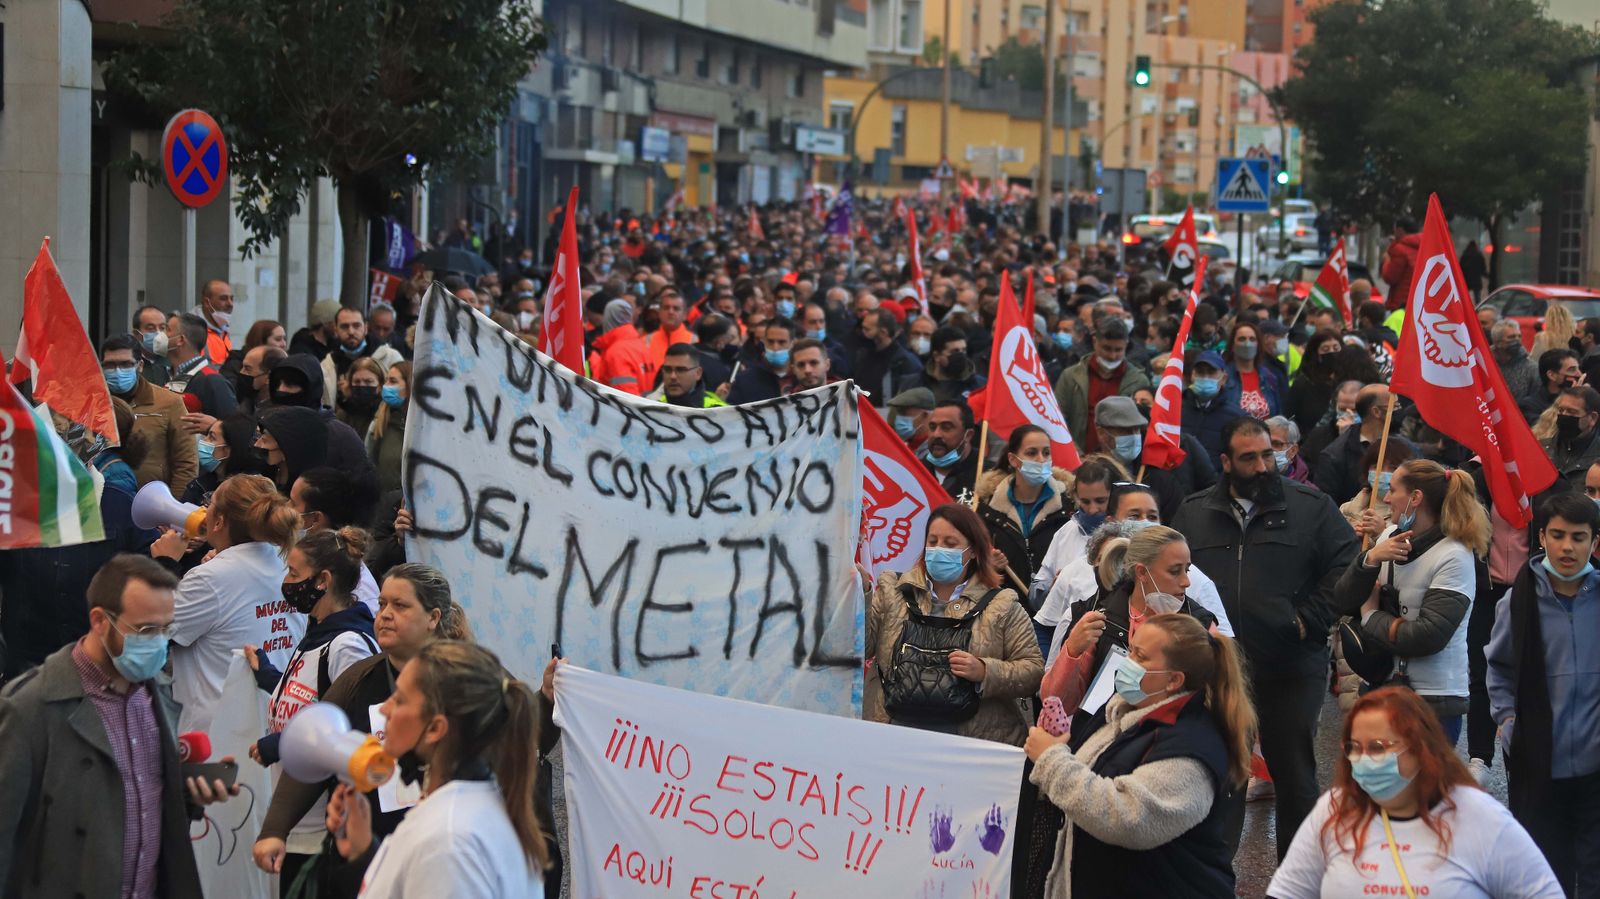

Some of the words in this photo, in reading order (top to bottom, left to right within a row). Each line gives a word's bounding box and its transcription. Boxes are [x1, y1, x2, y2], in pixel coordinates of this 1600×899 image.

[413, 365, 502, 443] EN
[508, 414, 574, 488] EL
[587, 449, 835, 519] CONVENIO
[407, 448, 549, 581] DEL
[262, 635, 294, 653] METAL
[271, 617, 289, 633] DEL
[554, 522, 864, 671] METAL
